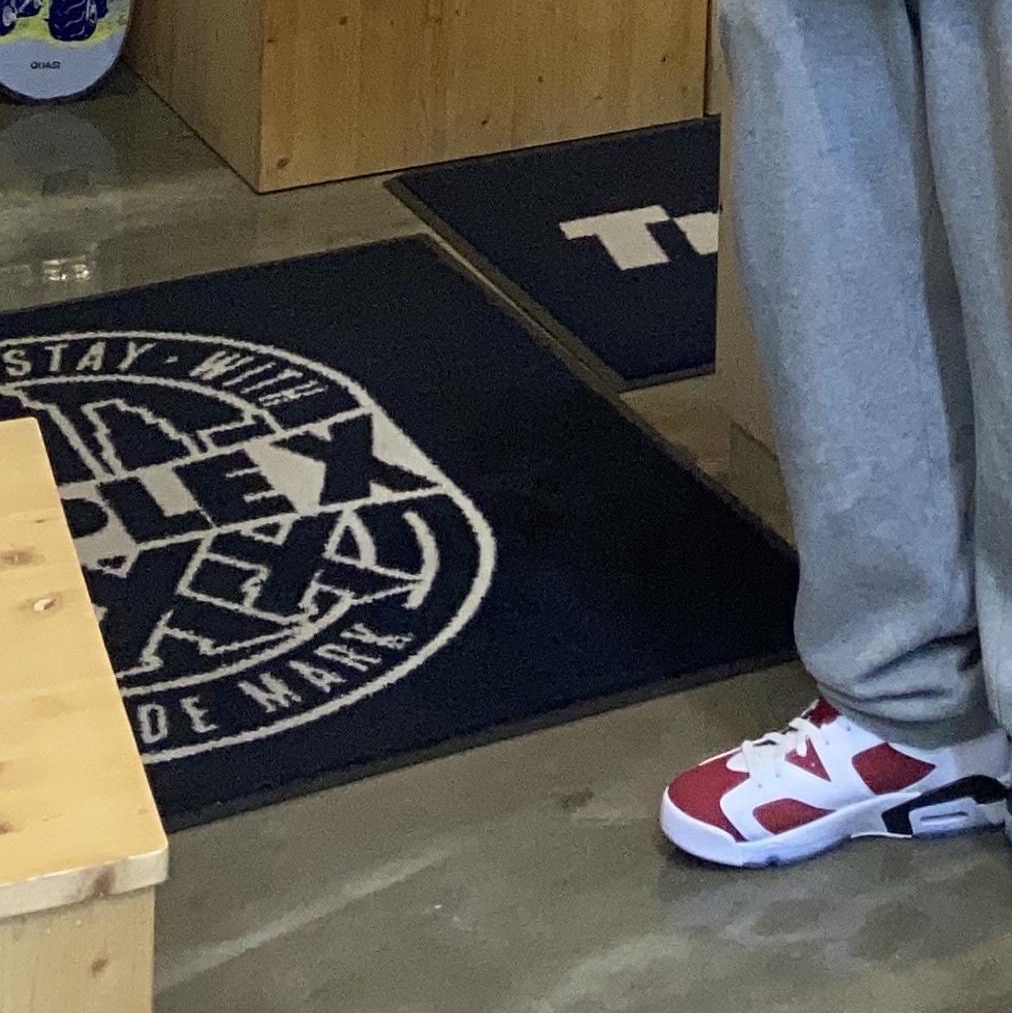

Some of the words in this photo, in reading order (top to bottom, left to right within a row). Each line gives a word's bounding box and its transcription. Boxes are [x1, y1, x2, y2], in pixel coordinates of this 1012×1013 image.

[2, 340, 157, 376] STAY
[189, 350, 328, 407] WITH
[237, 622, 414, 713] MARK
